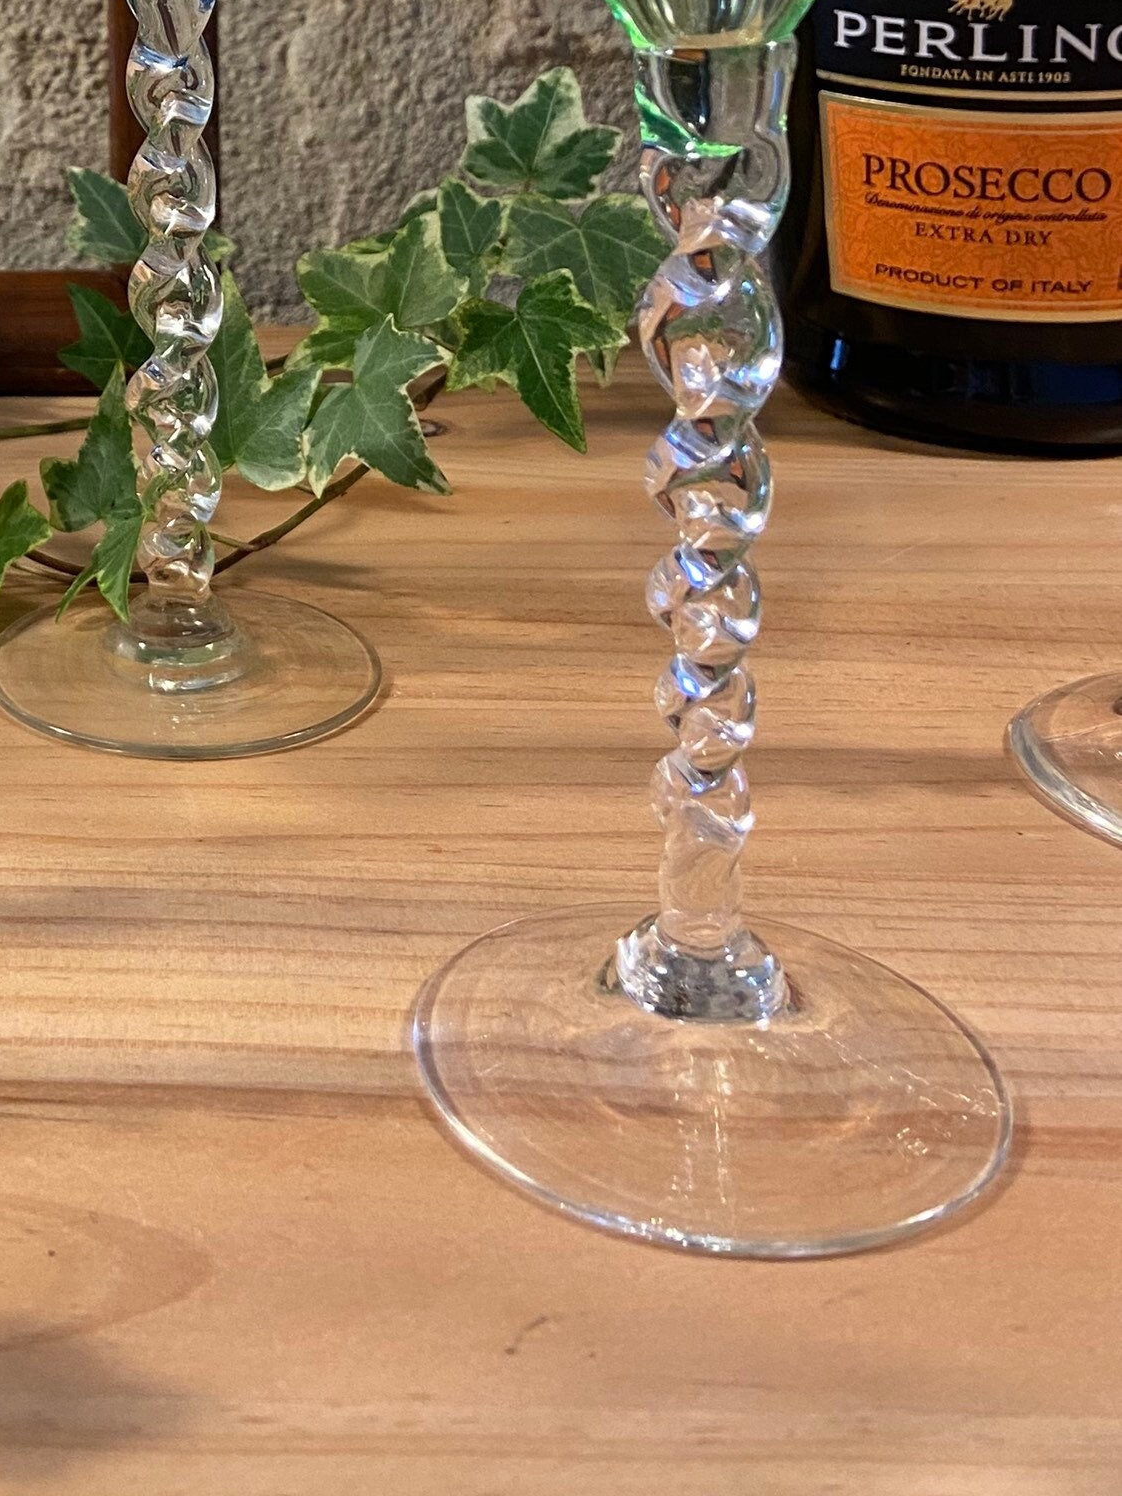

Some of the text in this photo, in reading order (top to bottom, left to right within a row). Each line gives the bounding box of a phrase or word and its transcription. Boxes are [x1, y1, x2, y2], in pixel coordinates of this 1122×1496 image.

[900, 64, 970, 81] FONDATA
[975, 70, 993, 82] IN
[998, 71, 1033, 84] ASTI
[861, 153, 1113, 203] PROSECCO
[864, 191, 965, 217] Denominazione
[982, 210, 1032, 224] origine
[1033, 208, 1108, 222] controllata
[915, 222, 1053, 246] EXTRA DRY
[875, 263, 1092, 294] PRODUCT OF ITALY
